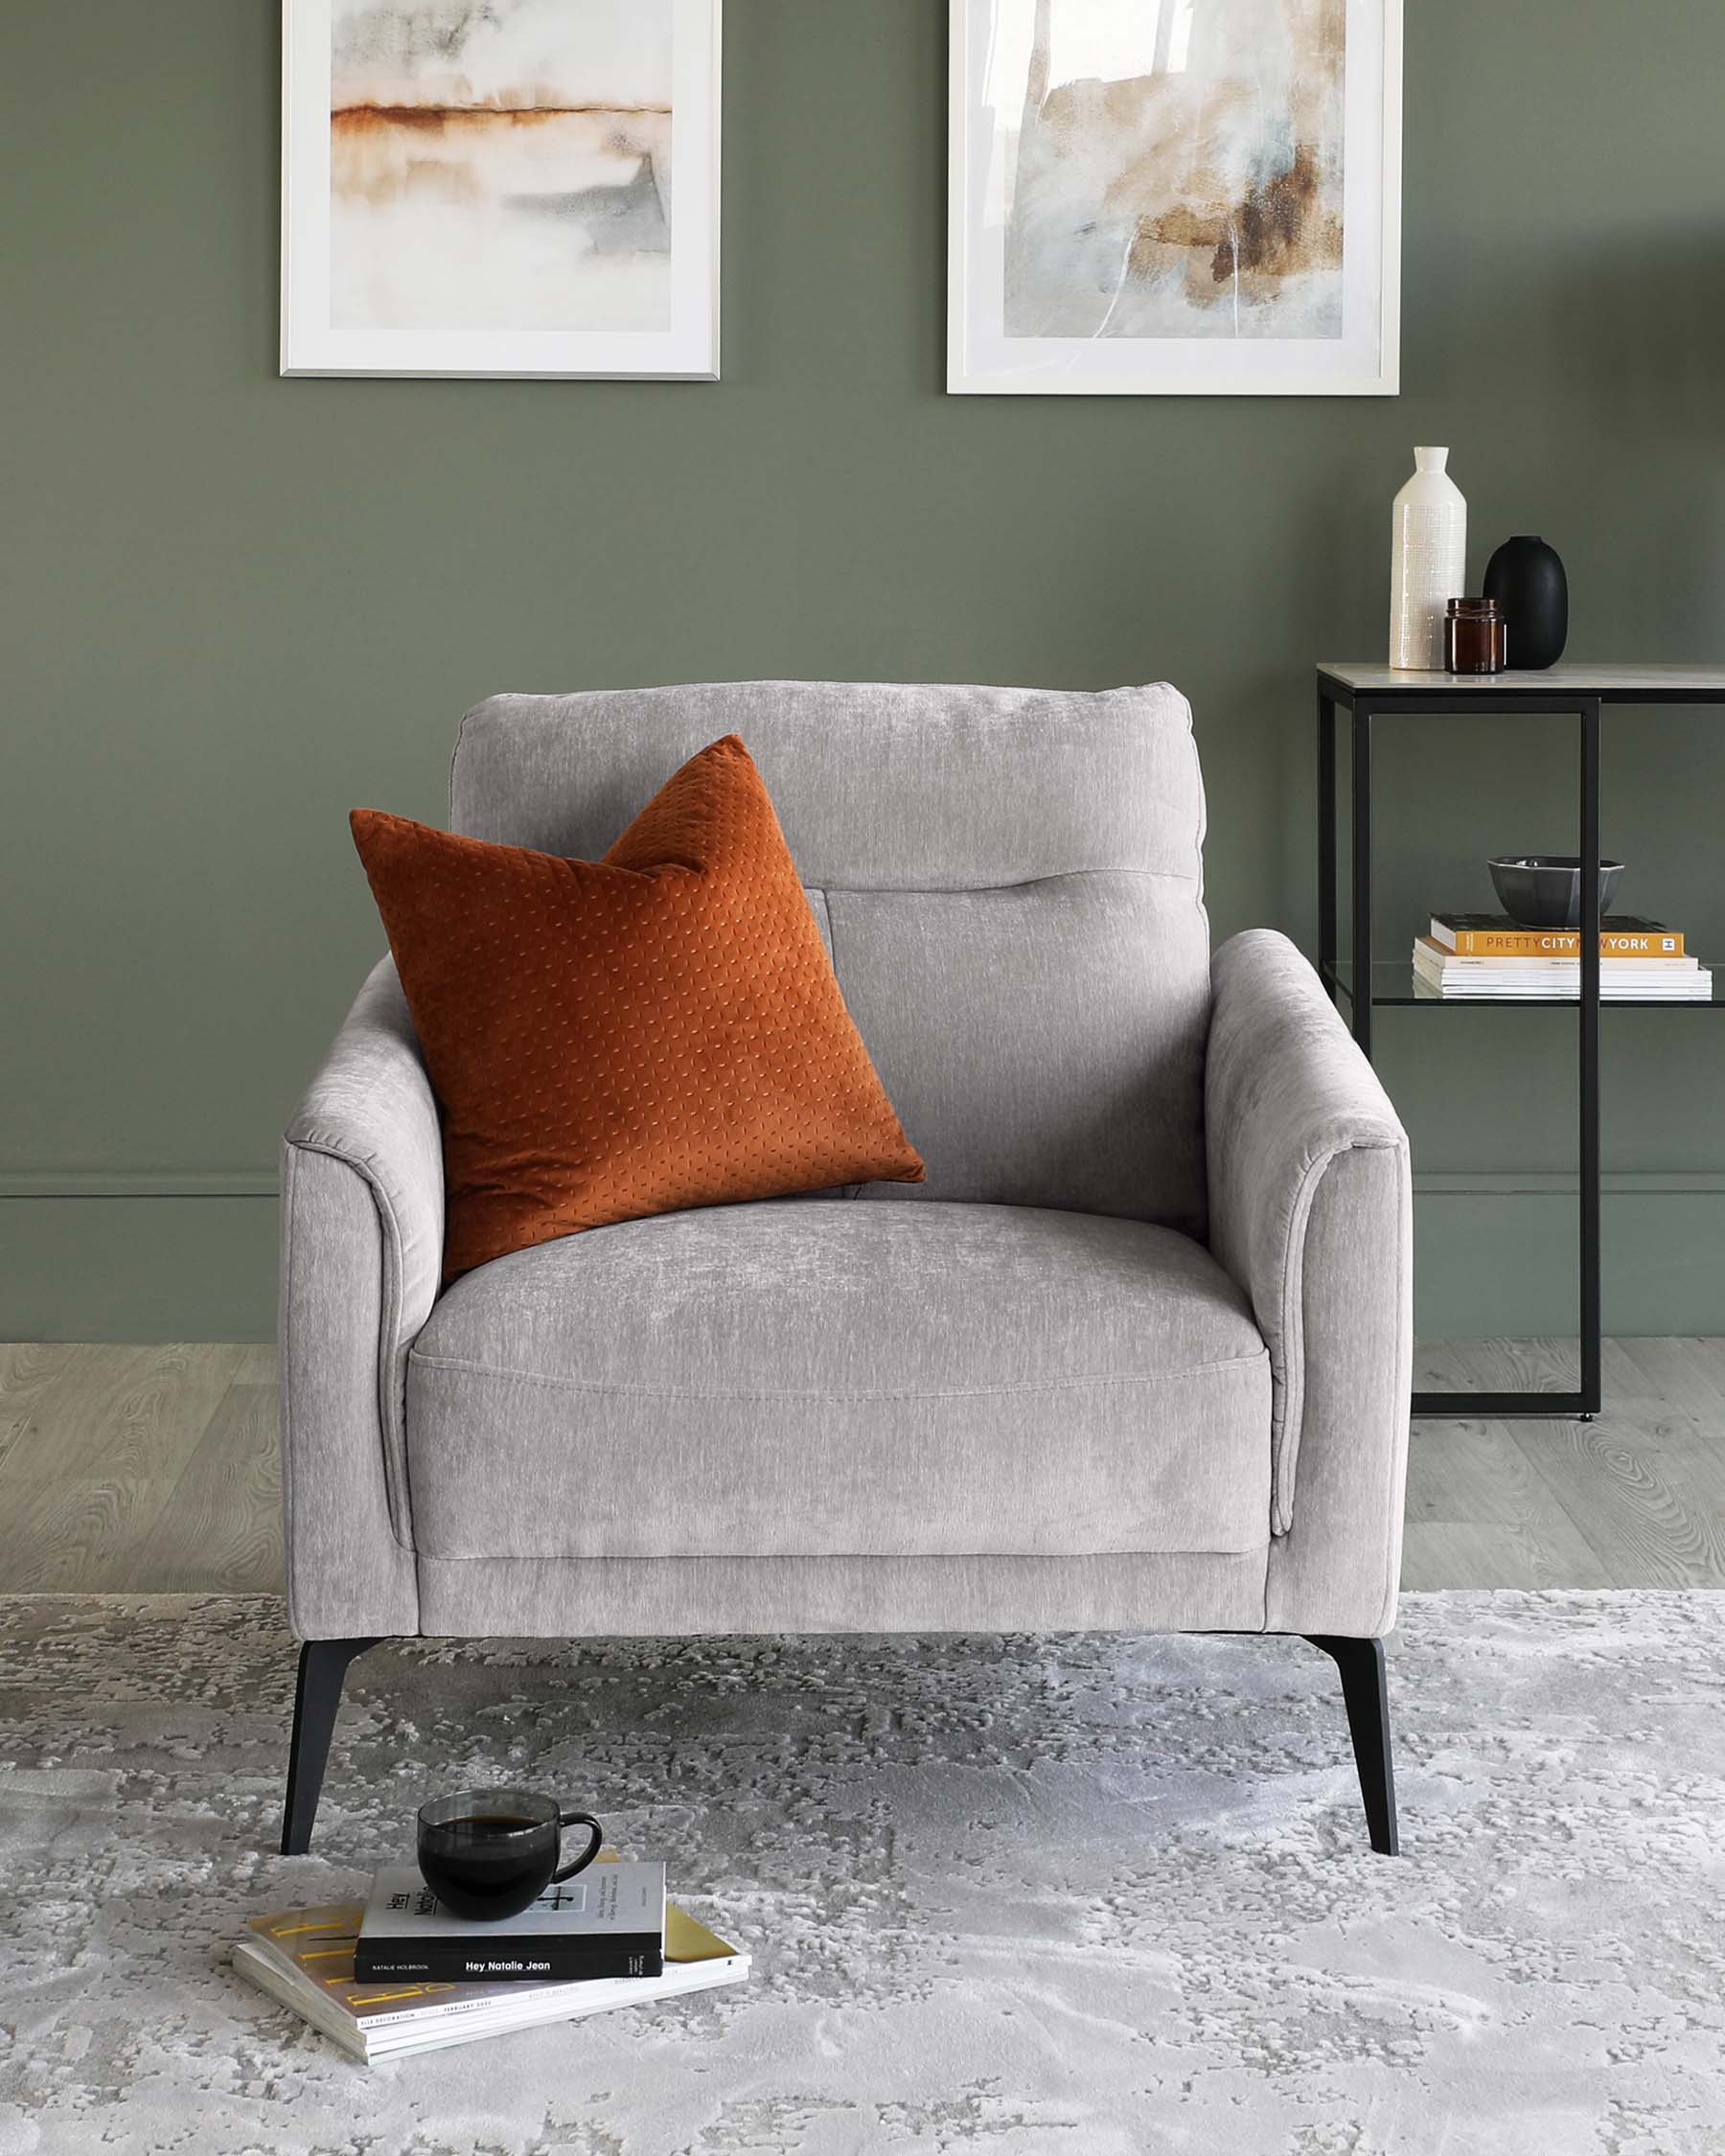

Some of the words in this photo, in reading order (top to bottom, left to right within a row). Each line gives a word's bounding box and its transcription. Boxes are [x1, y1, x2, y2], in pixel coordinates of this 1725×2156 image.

[1486, 937, 1540, 949] PRETTY
[1541, 937, 1575, 949] CITY
[1610, 938, 1648, 950] YORK
[466, 1961, 485, 1972] Hey
[488, 1961, 523, 1970] Natalie
[526, 1961, 551, 1970] Jean
